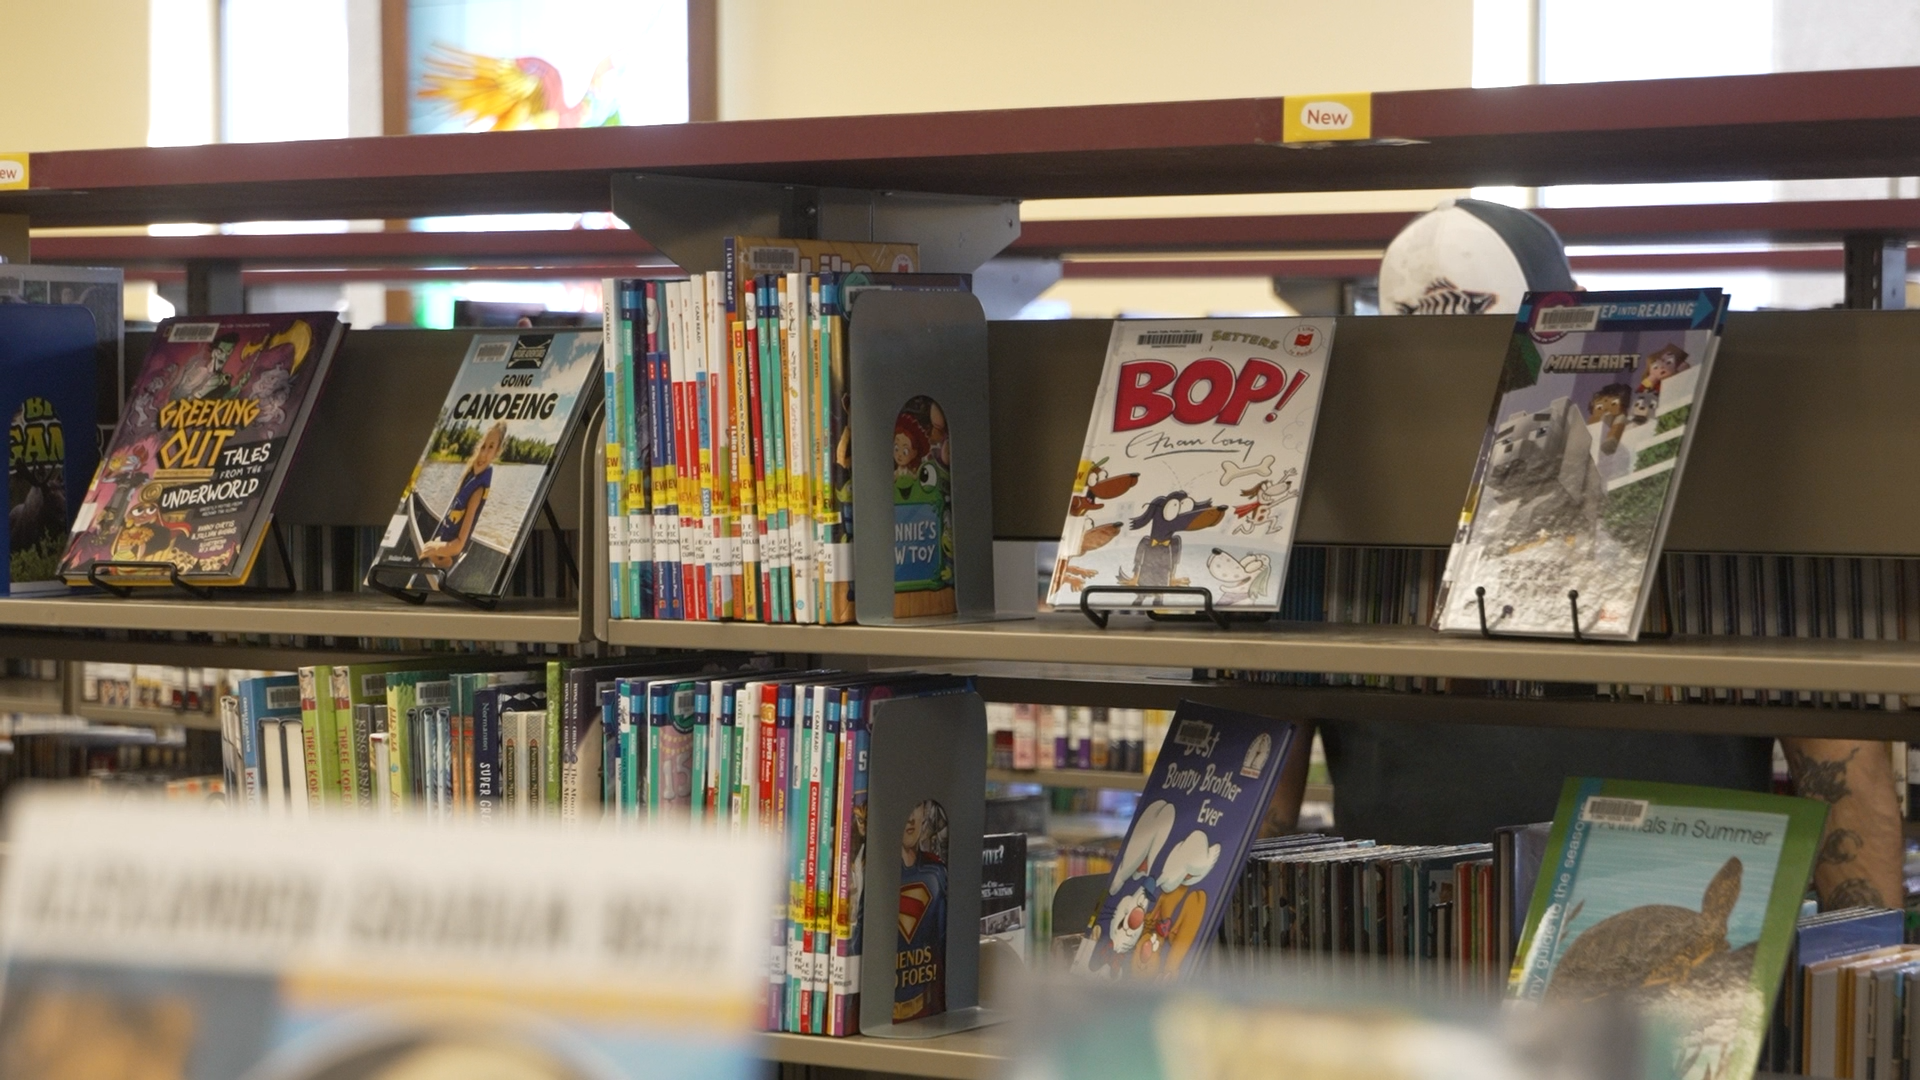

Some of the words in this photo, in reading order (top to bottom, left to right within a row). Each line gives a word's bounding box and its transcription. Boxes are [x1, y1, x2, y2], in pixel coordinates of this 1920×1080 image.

[1307, 110, 1348, 124] New
[0, 168, 17, 179] ew
[1618, 307, 1636, 316] INTO
[1638, 303, 1694, 317] READING
[1212, 330, 1280, 350] SETTERS
[1544, 354, 1641, 374] MINECRAFT
[501, 374, 534, 388] GOING
[453, 392, 558, 420] CANOEING
[1112, 357, 1310, 433] BOP!
[26, 398, 52, 418] BI
[160, 398, 260, 429] GREEKING
[160, 428, 236, 469] OUT
[223, 442, 271, 466] TALES
[220, 468, 243, 479] FROM
[607, 458, 618, 466] EW
[700, 464, 710, 472] EW
[162, 478, 259, 509] UNDERWORLD
[630, 484, 641, 493] EW
[654, 482, 667, 490] EW
[712, 490, 724, 499] EW
[702, 489, 710, 515] SSION
[895, 521, 936, 541] NNIE'S
[909, 544, 935, 563] TOY
[305, 727, 314, 765] THREE
[339, 727, 348, 764] THREE
[308, 770, 319, 810] KOREA
[340, 769, 351, 810] KOREA
[361, 763, 369, 810] SENDA
[480, 762, 491, 796] SUPER
[1162, 762, 1201, 794] Bunny
[1200, 763, 1242, 802] Brother
[1197, 799, 1223, 827] Ever
[1670, 817, 1688, 836] in
[1692, 819, 1772, 845] Summer
[1529, 974, 1544, 998] my
[1554, 873, 1570, 898] the
[896, 946, 932, 969] IENDS
[902, 964, 937, 988] FOES!
